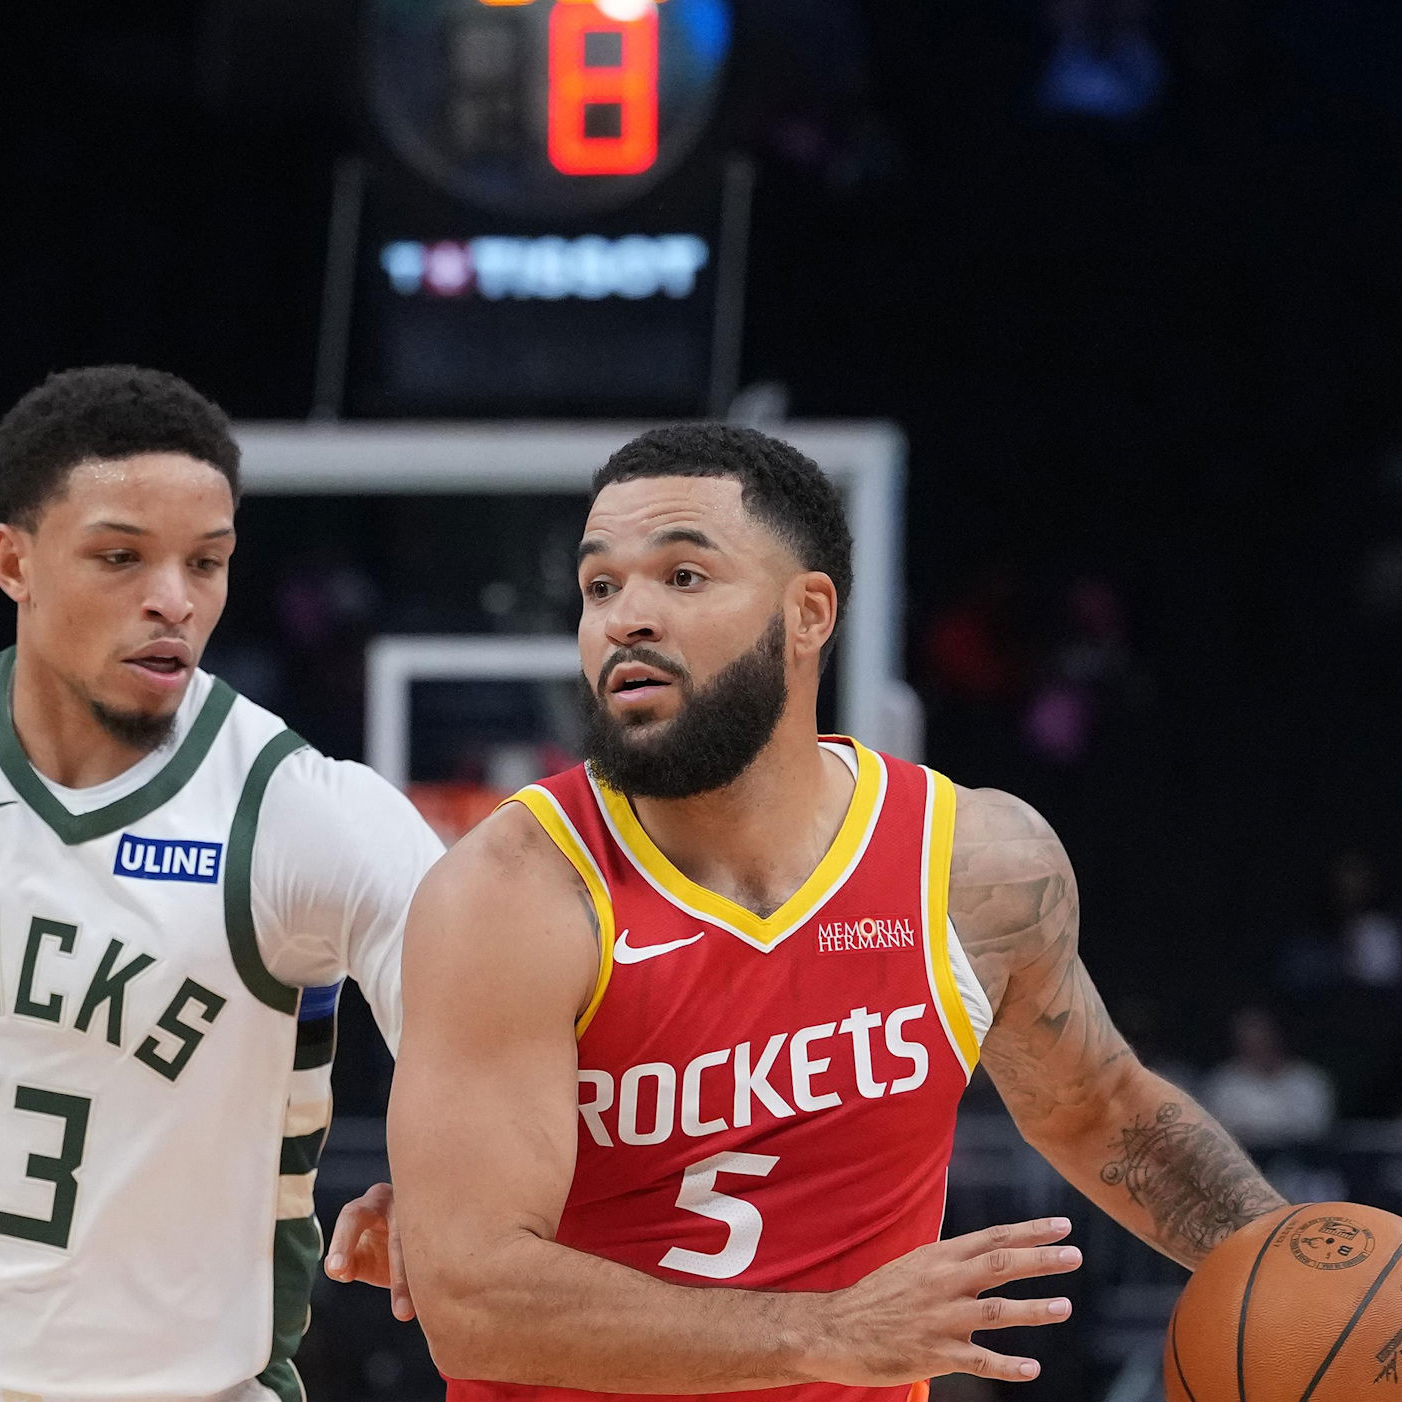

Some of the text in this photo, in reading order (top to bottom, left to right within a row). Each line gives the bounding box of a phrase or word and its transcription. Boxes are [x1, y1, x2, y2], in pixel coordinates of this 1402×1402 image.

[548, 0, 658, 175] 8
[121, 841, 217, 877] ULINE
[818, 918, 914, 939] MEMORIAL
[819, 932, 914, 952] HERMANN
[658, 1151, 781, 1279] 5
